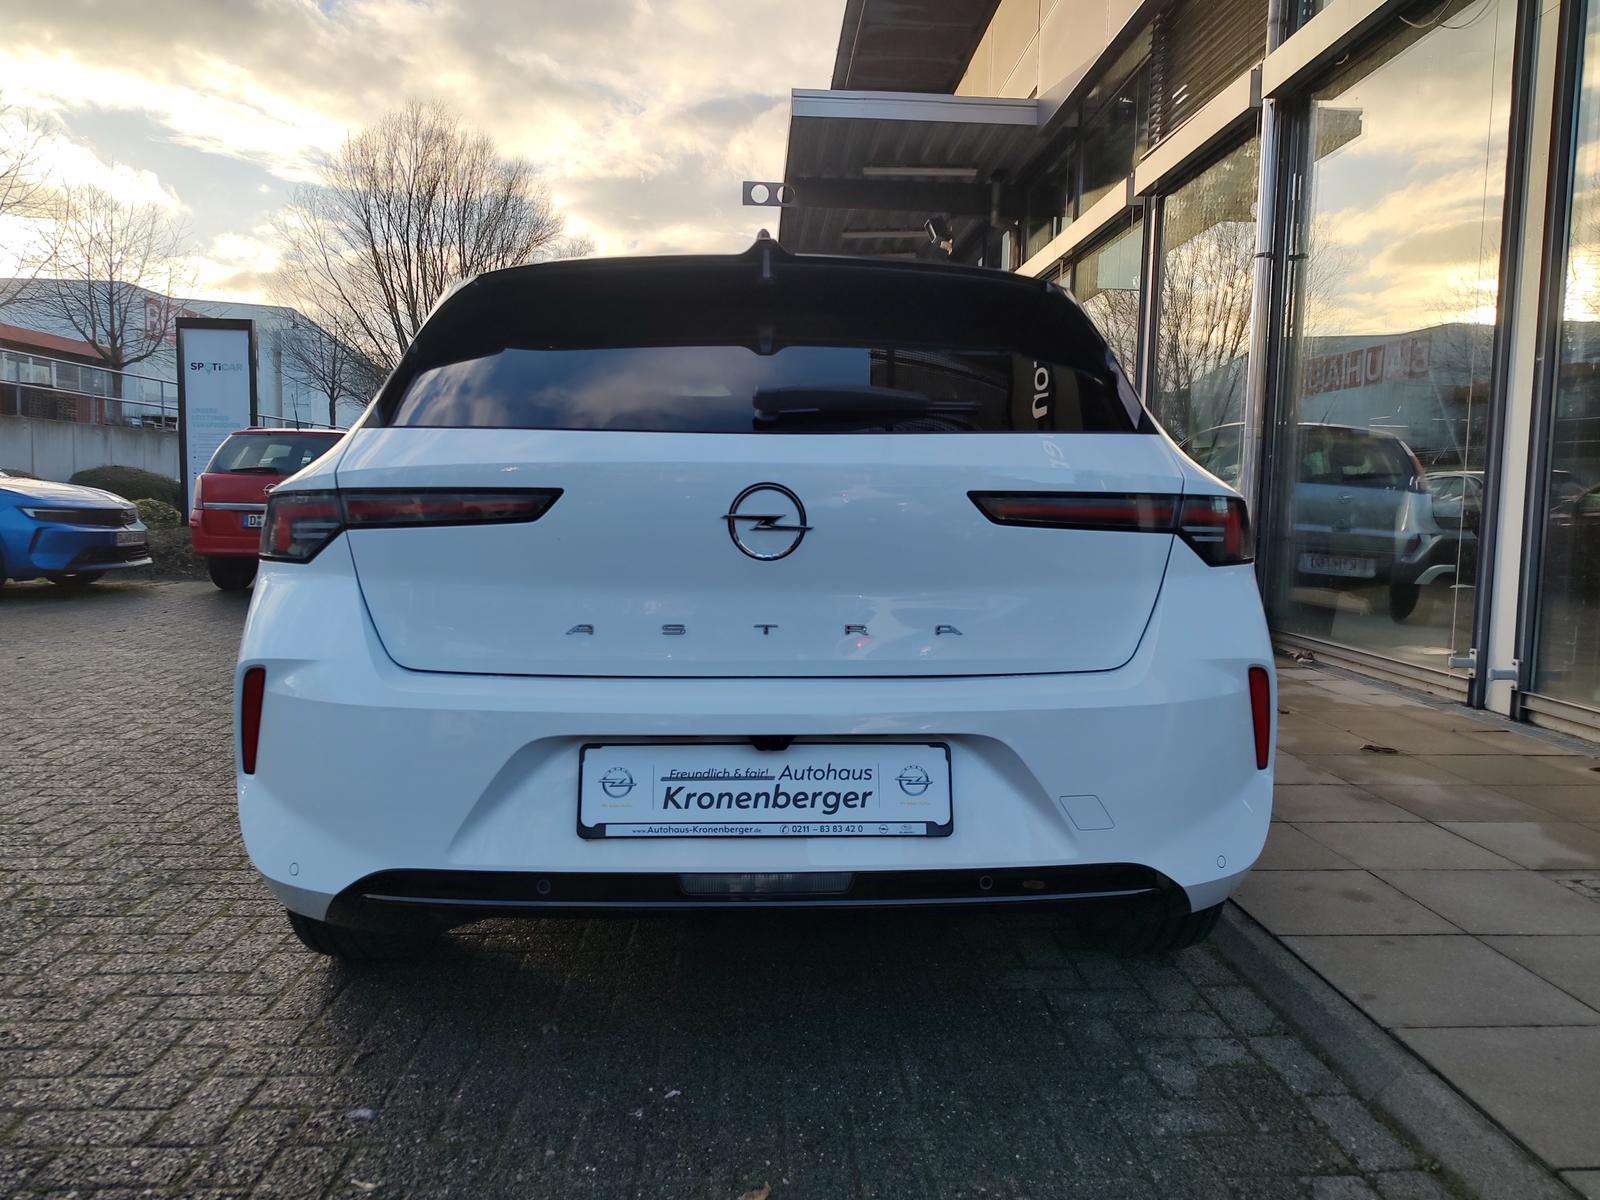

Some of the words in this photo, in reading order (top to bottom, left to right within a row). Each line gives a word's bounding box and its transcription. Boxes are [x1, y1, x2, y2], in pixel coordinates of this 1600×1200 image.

[565, 623, 964, 636] ASTRA
[669, 768, 730, 781] Freundlich
[733, 768, 741, 779] &
[778, 763, 873, 781] Autohaus
[662, 783, 873, 816] Kronenberger
[791, 825, 810, 833] 0211
[820, 825, 830, 833] 83
[832, 825, 843, 833] 83
[845, 825, 857, 833] 42
